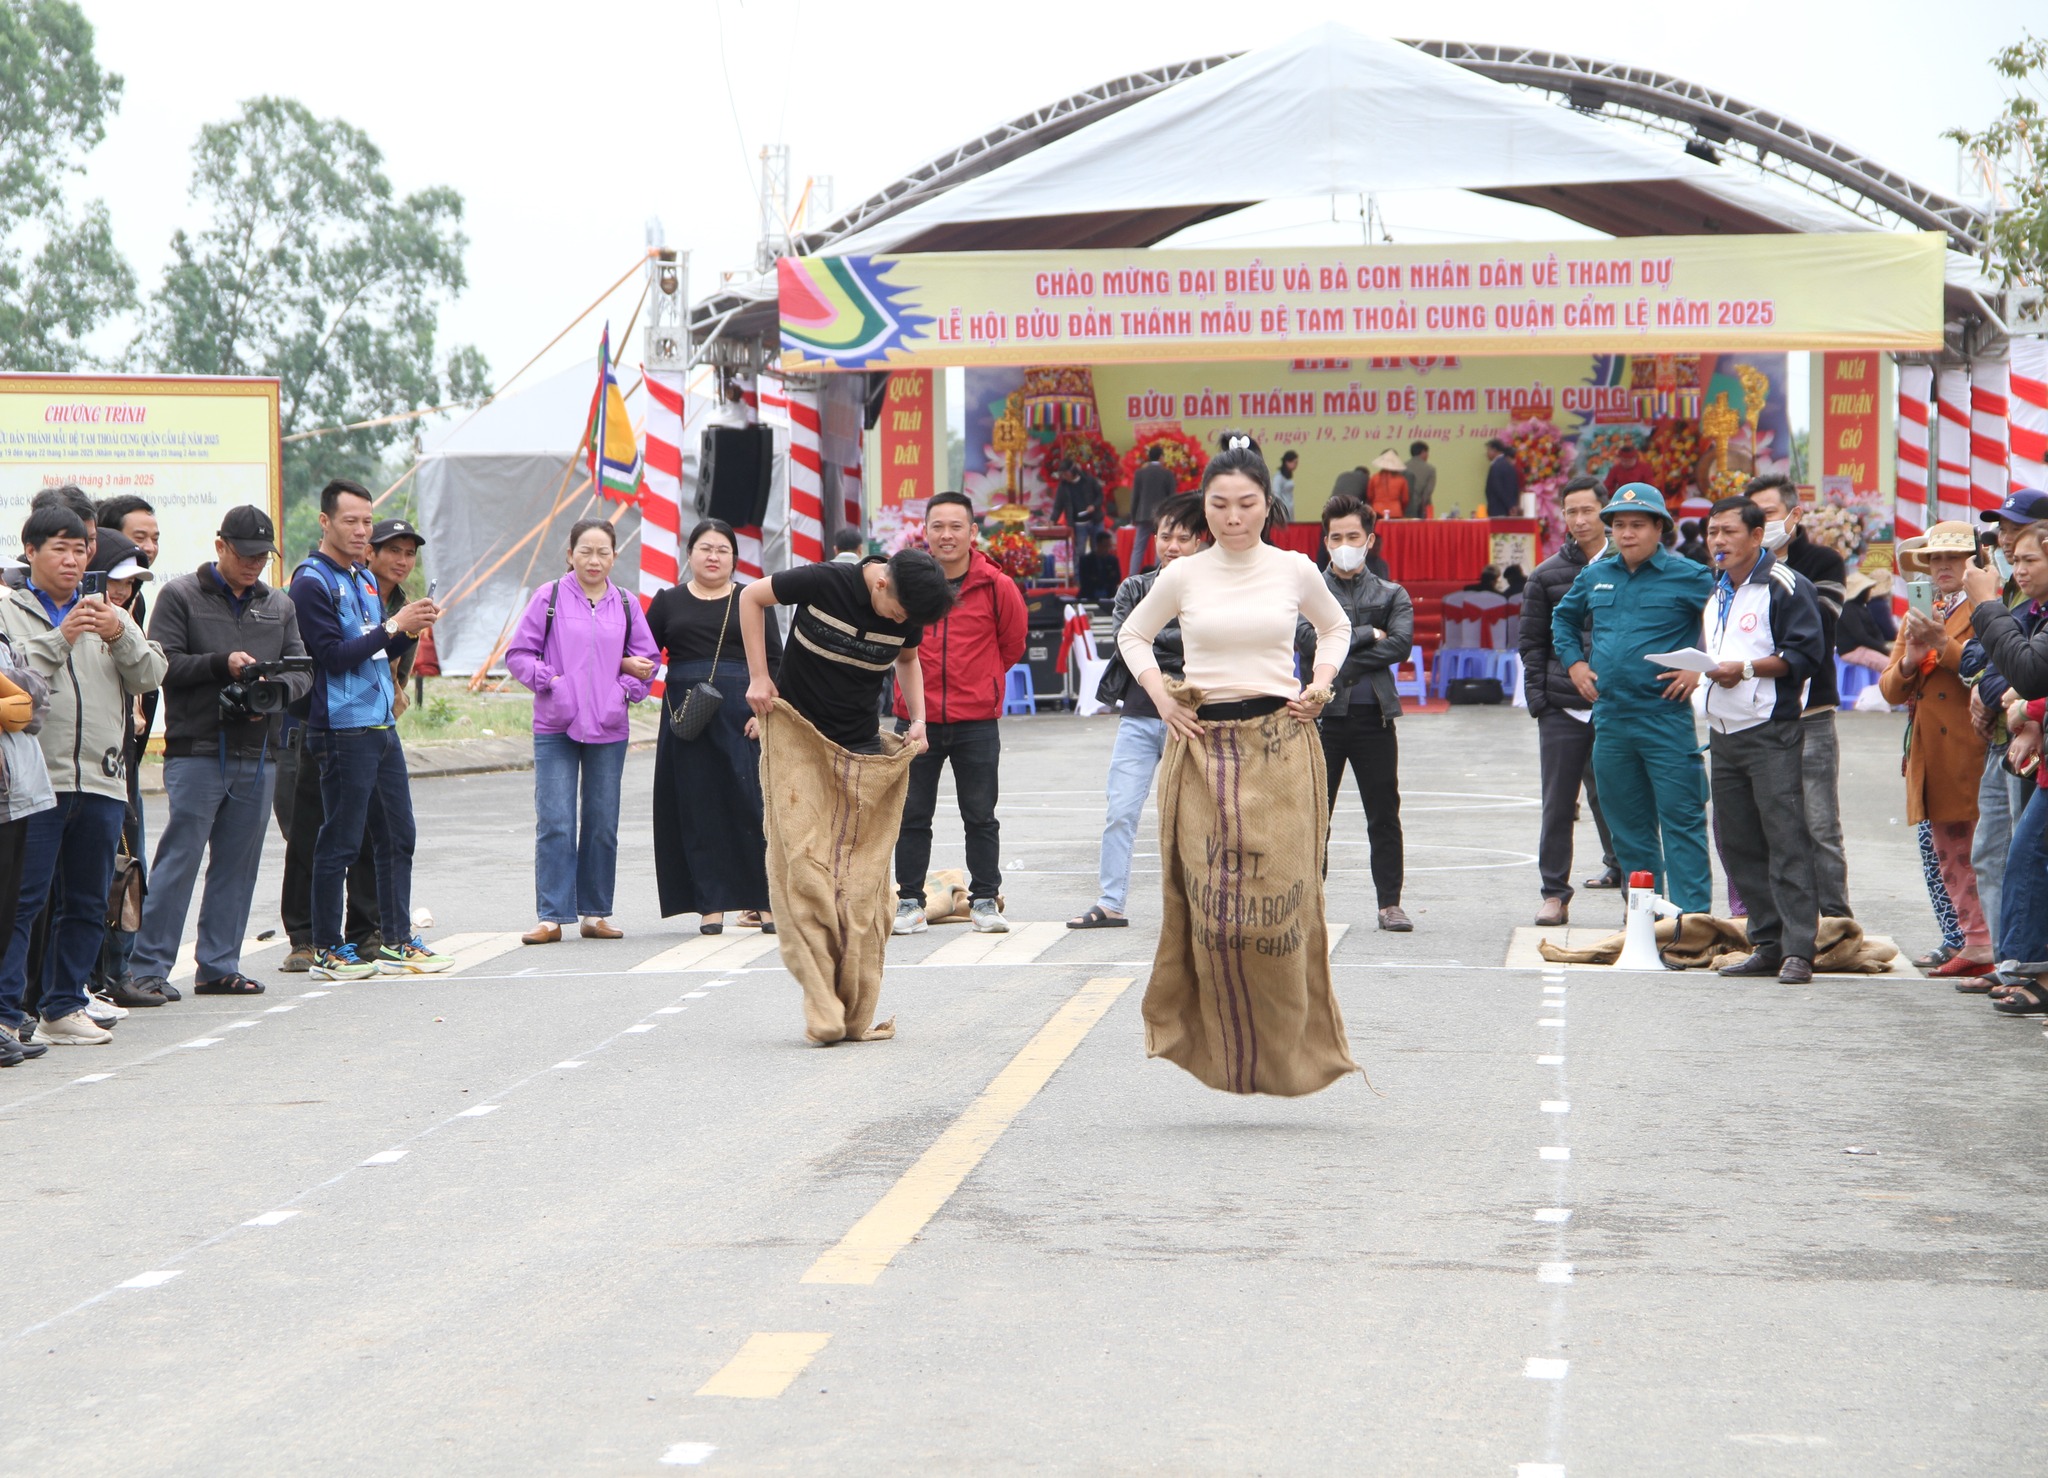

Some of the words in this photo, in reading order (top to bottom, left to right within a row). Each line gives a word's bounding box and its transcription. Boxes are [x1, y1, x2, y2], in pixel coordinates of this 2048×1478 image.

[1036, 267, 1095, 297] CHÀO
[1102, 265, 1170, 296] MỪNG
[1178, 269, 1216, 300] ĐẠI
[1224, 258, 1275, 293] BIỂU
[1283, 262, 1311, 291] VÀ
[1319, 261, 1349, 290] BÀ
[1356, 264, 1401, 290] CON
[1410, 259, 1471, 288] NHÂN
[1478, 258, 1524, 287] DÂN
[1531, 253, 1559, 286] VỀ
[1566, 260, 1633, 286] THAM
[1640, 259, 1674, 291] DỰ
[938, 307, 961, 341] LỄ
[969, 310, 1007, 345] HỘI
[1015, 306, 1060, 339] BỬU
[1068, 305, 1112, 338] ĐẢN
[1120, 305, 1192, 335] THÁNH
[1200, 301, 1252, 334] MẪU
[1260, 303, 1288, 339] ĐỆ
[1295, 307, 1345, 332] TAM
[1352, 299, 1417, 331] THOẢI
[1426, 304, 1486, 330] CUNG
[1494, 298, 1555, 335] QUẬN
[1563, 292, 1616, 327] CẨM
[1624, 297, 1649, 332] LỆ
[1657, 297, 1710, 327] NĂM
[1717, 300, 1775, 326] 2025
[1836, 357, 1867, 380] MƯA
[889, 369, 924, 404] QUỐC
[44, 402, 102, 423] CHƯƠNG
[105, 401, 148, 423] TRÌNH
[1127, 388, 1175, 419] BỬU
[1183, 387, 1231, 417] ĐẢN
[1239, 387, 1314, 416] THÁNH
[1322, 382, 1378, 414] MẪU
[1386, 385, 1417, 419] ĐỆ
[1424, 388, 1476, 412] TAM
[1562, 385, 1627, 410] CUNG
[1830, 388, 1875, 419] THUẬN
[892, 406, 922, 432] THÁI
[1342, 425, 1360, 441] 20
[1386, 424, 1403, 440] 21
[1408, 424, 1452, 442] tháng
[1457, 425, 1465, 438] 3
[894, 440, 921, 465] DÂN
[79, 473, 103, 488] tháng
[106, 474, 112, 486] 3
[114, 474, 132, 486] năm
[134, 473, 155, 486] 2025
[898, 478, 918, 499] AN
